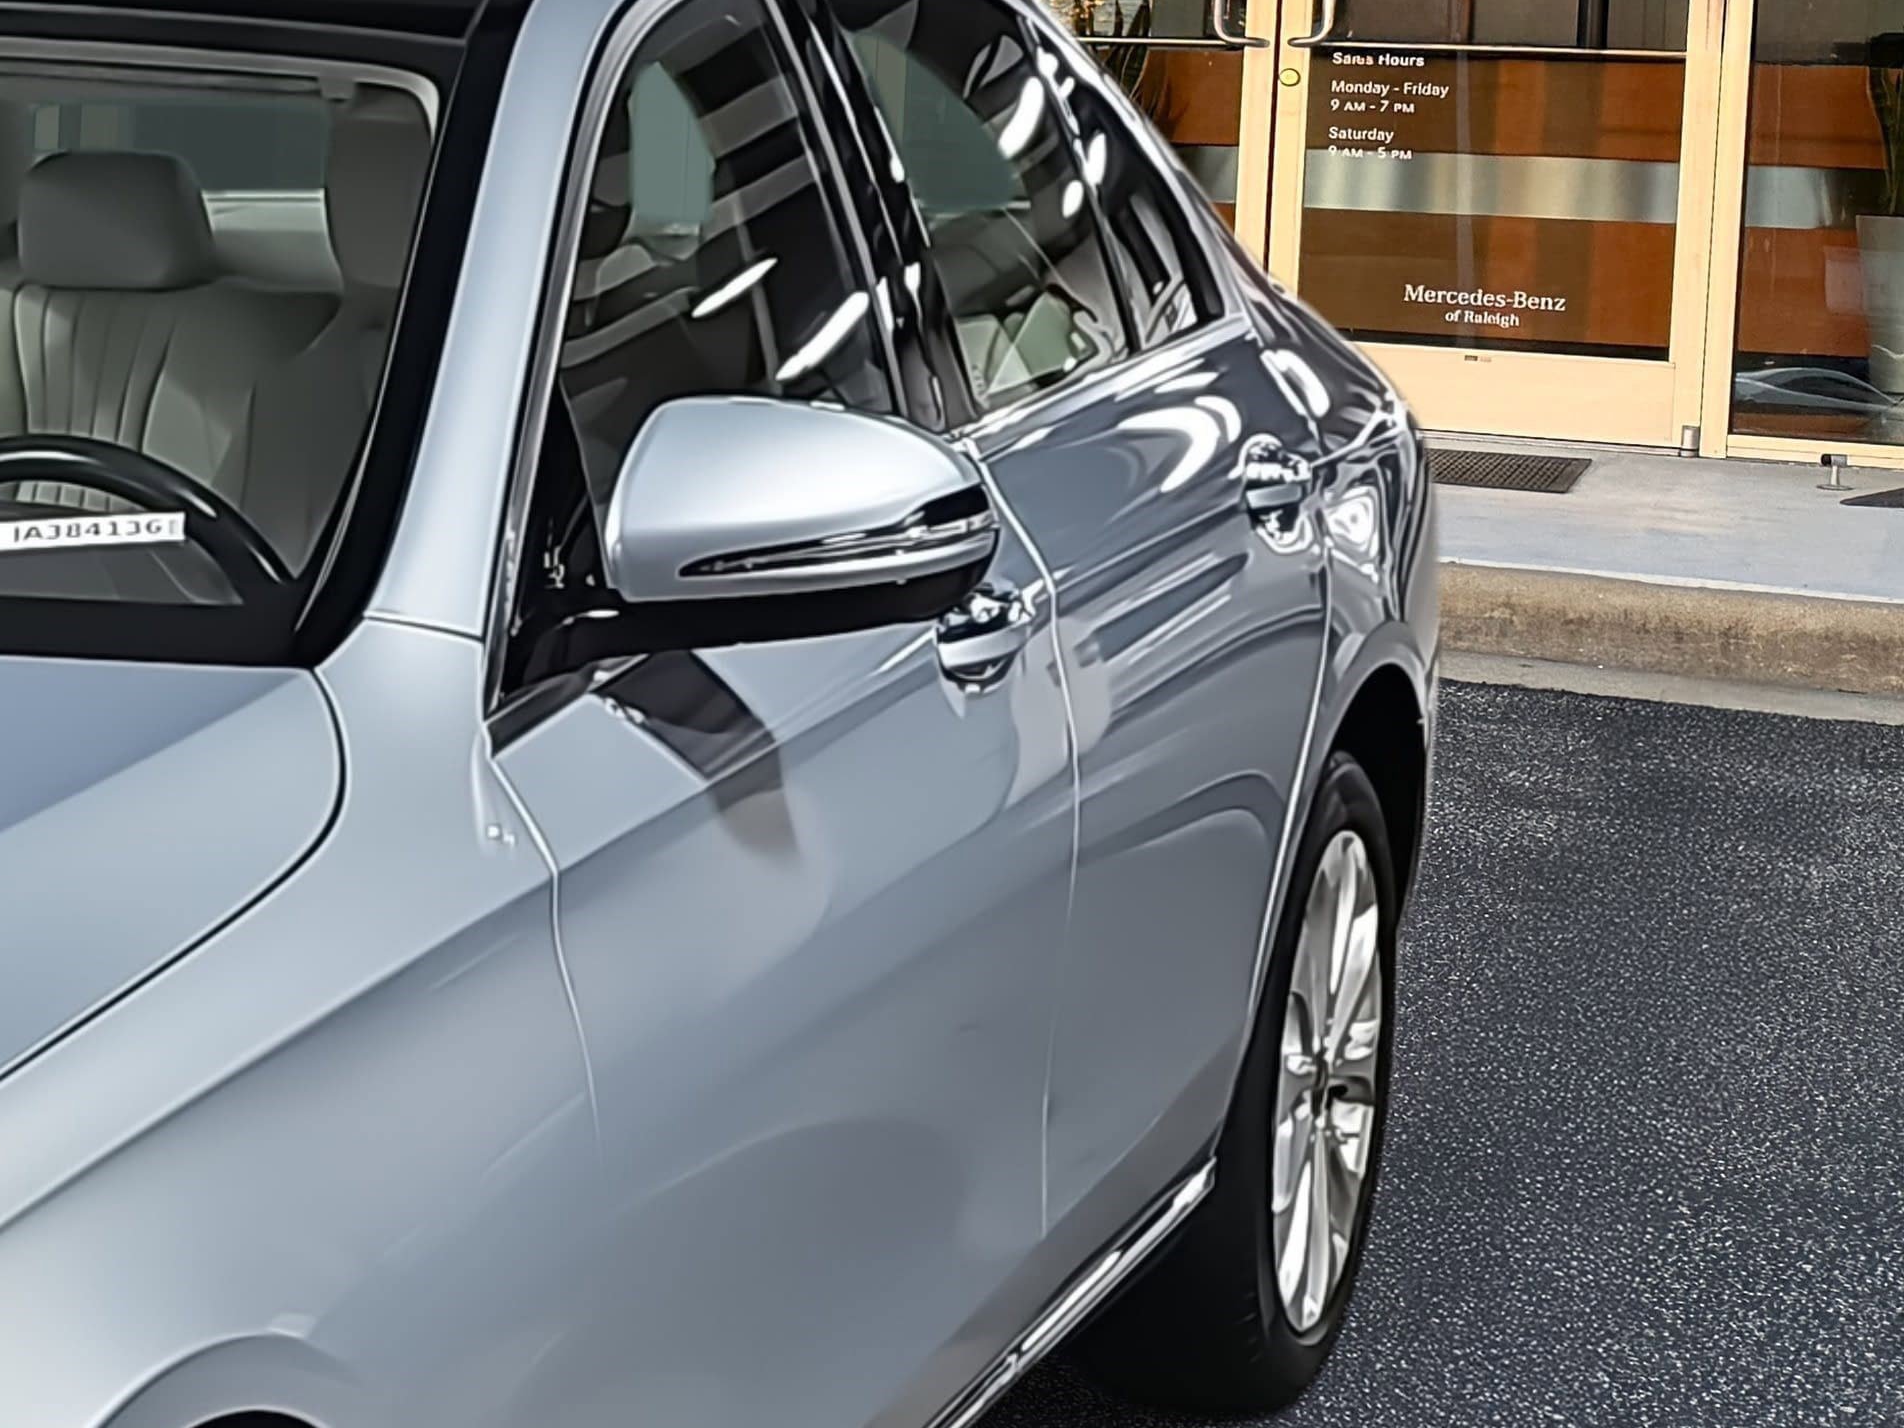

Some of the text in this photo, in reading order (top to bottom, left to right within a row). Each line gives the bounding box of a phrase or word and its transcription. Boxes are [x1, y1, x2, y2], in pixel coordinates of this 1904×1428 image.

[1378, 52, 1425, 67] Hours
[1331, 79, 1390, 97] Monday
[1403, 82, 1450, 99] Friday
[1329, 99, 1340, 112] 9
[1344, 102, 1366, 112] AM
[1379, 100, 1390, 113] 7
[1393, 103, 1415, 113] PM
[1328, 126, 1395, 144] Saturday
[1327, 145, 1337, 157] 9
[1341, 148, 1364, 158] AM
[1377, 147, 1387, 159] 5
[1391, 149, 1413, 160] PM
[1403, 284, 1567, 312] Mercedes-Benz
[1445, 309, 1521, 329] of Raleigh
